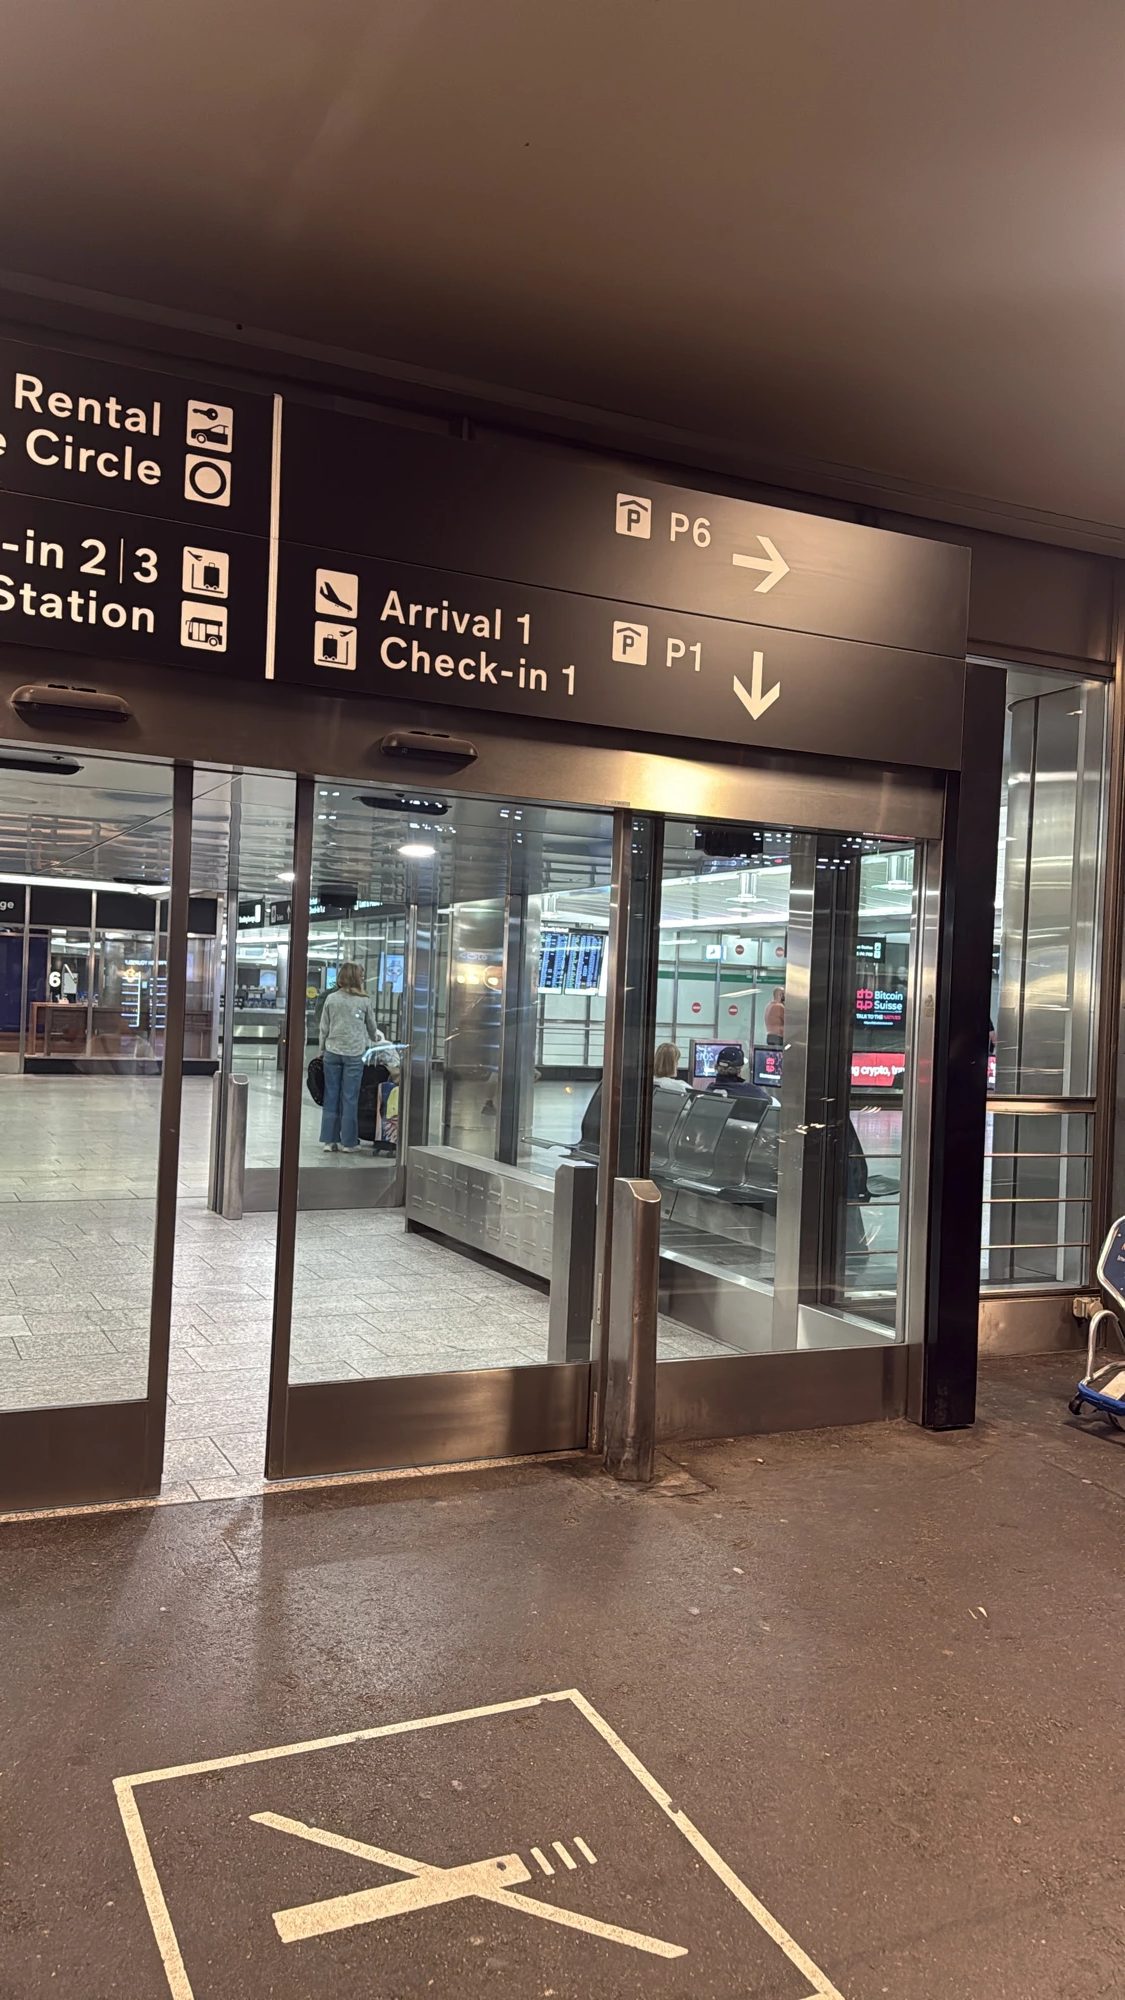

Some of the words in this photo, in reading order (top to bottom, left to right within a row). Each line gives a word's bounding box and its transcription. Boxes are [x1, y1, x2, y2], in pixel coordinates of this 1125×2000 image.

[14, 372, 161, 437] Rental
[25, 428, 162, 485] Circle
[670, 511, 711, 548] P6
[0, 574, 155, 633] Station
[380, 590, 502, 640] Arrival
[516, 613, 531, 645] 1
[380, 636, 548, 692] Check-in
[561, 664, 576, 696] 1
[666, 637, 702, 672] P1
[48, 971, 61, 988] 6
[874, 991, 903, 1001] Bitcoin
[873, 1001, 902, 1010] Suisse
[860, 1065, 891, 1077] crypto,
